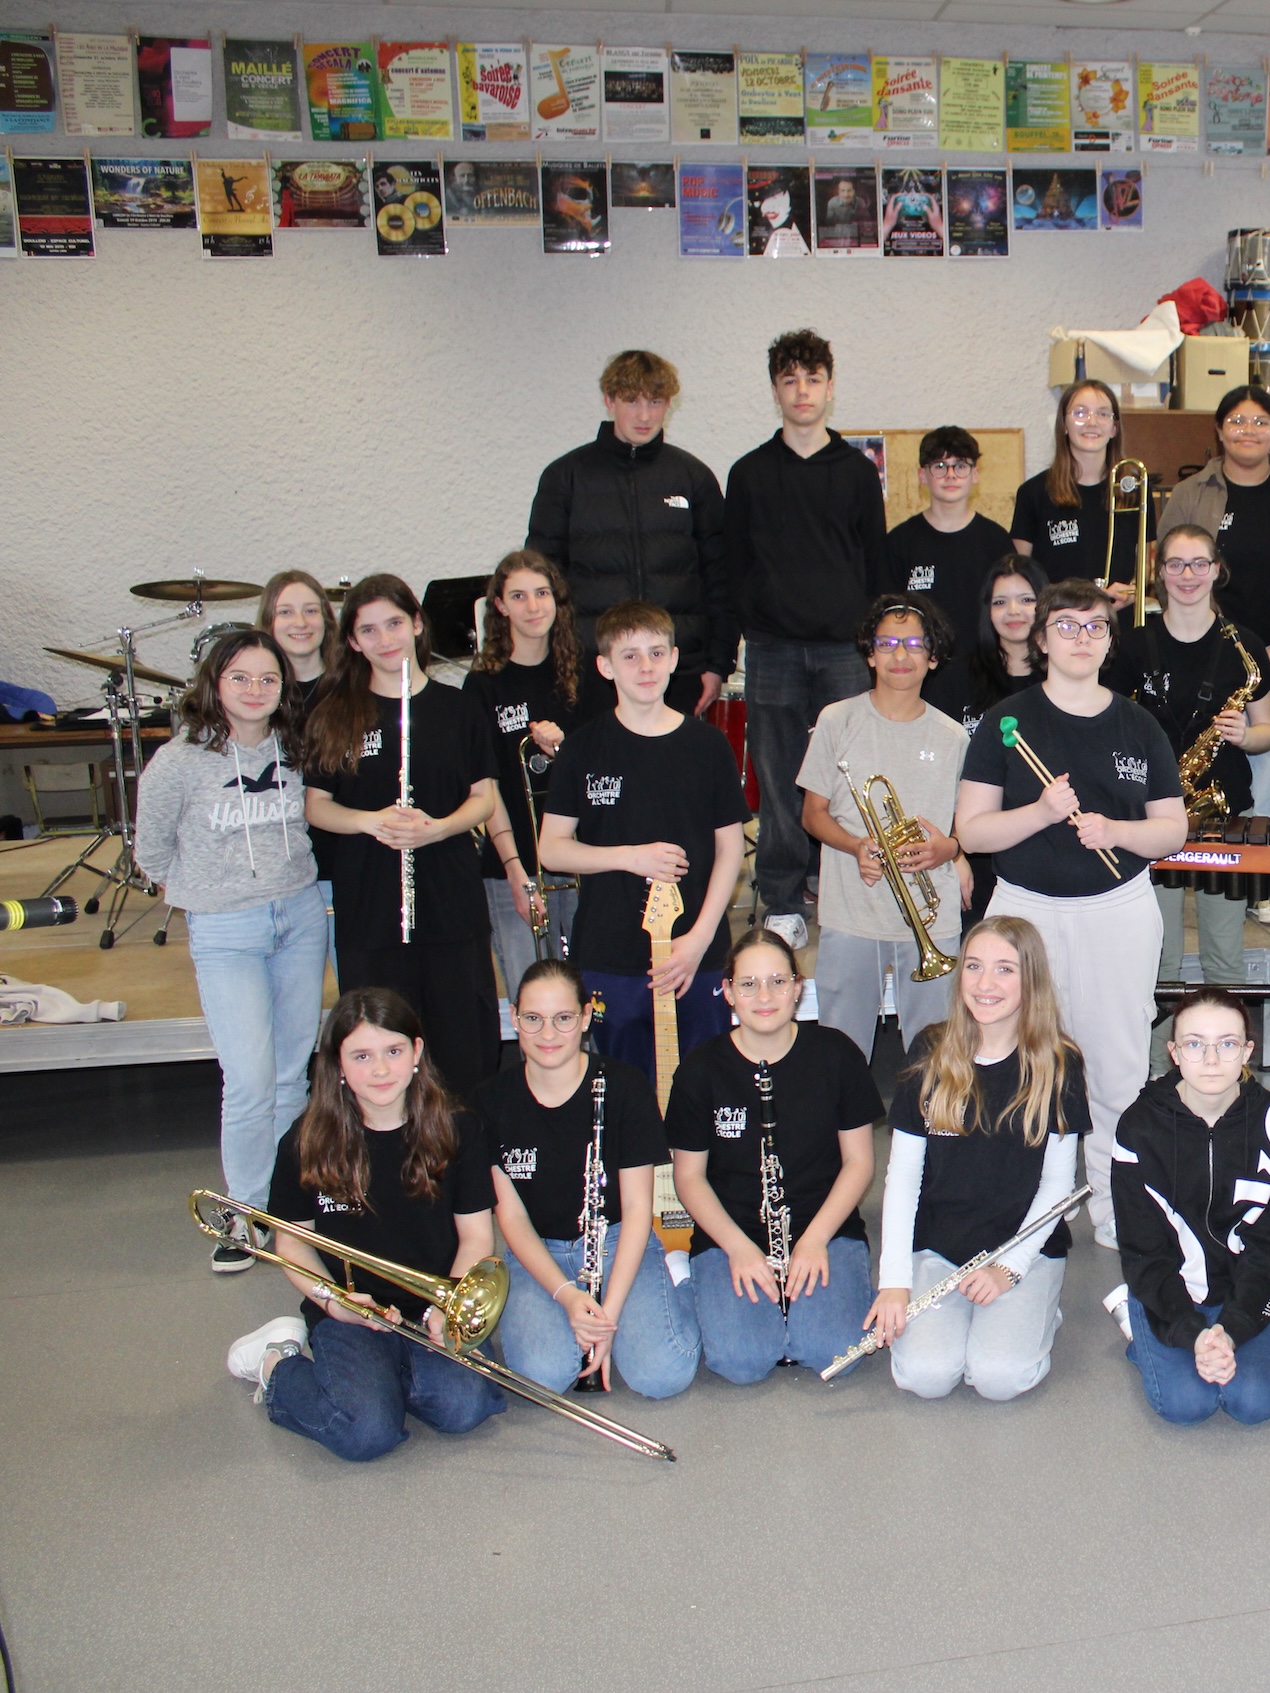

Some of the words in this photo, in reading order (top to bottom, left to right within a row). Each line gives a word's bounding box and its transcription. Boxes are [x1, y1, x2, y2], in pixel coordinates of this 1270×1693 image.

[307, 47, 361, 69] CONCERT
[740, 54, 759, 64] POIX
[231, 61, 293, 76] MAILLÉ
[241, 75, 293, 85] CONCERT
[876, 78, 933, 98] dansante
[1147, 80, 1198, 102] dansante
[100, 164, 141, 175] WONDERS
[142, 165, 152, 175] OF
[154, 165, 184, 175] NATURE
[682, 176, 705, 187] POP
[473, 187, 537, 210] OFFENBACH
[682, 187, 719, 198] MUSIC
[891, 231, 908, 239] JEUX
[208, 794, 301, 832] Holliste
[1163, 851, 1241, 866] ERGERAULT
